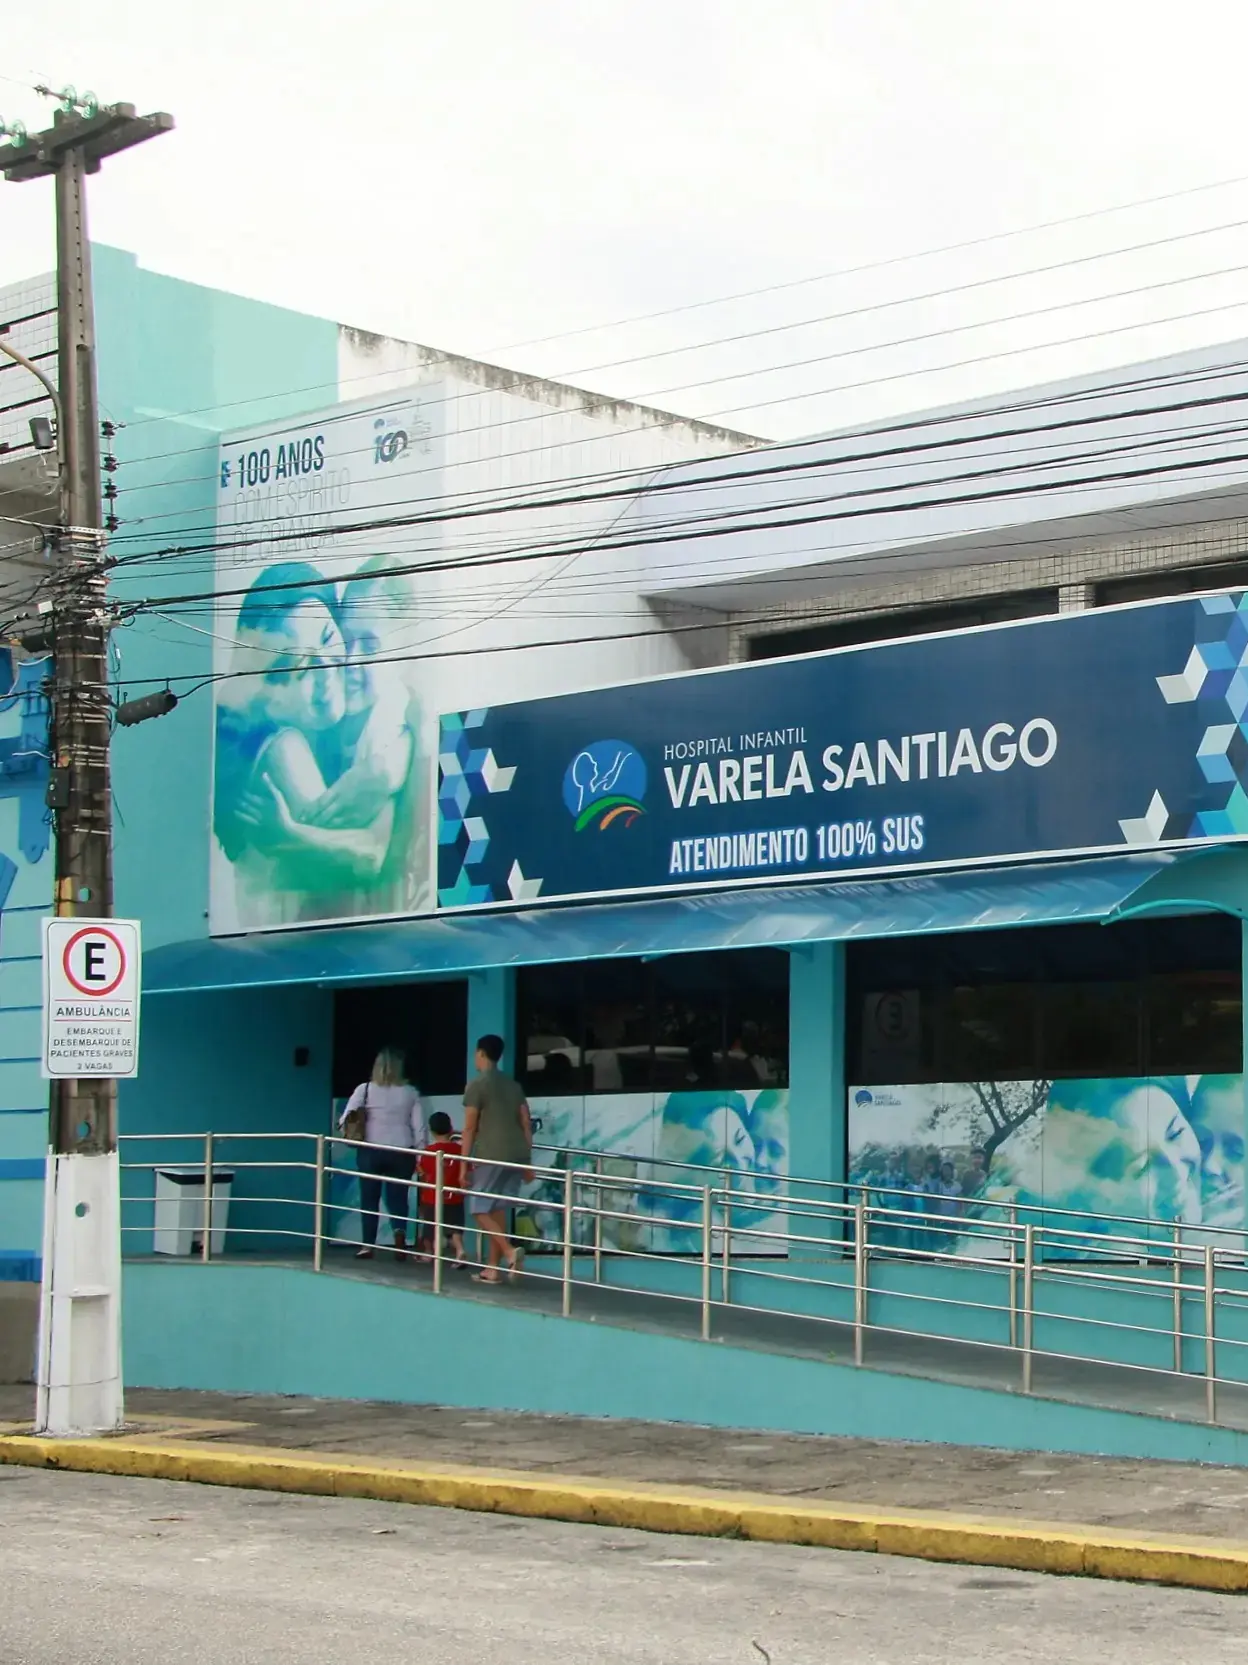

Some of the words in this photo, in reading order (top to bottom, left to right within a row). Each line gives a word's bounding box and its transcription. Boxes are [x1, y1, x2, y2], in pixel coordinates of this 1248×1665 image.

[238, 448, 270, 489] 100
[275, 435, 325, 480] ANOS
[664, 738, 734, 761] HOSPITAL
[739, 727, 808, 750] INFANTIL
[664, 751, 814, 809] VARELA
[821, 717, 1059, 792] SANTIAGO
[669, 828, 808, 874] ATENDIMENTO
[816, 820, 877, 859] 100%
[882, 815, 925, 853] SUS
[85, 942, 106, 981] E
[56, 1004, 131, 1017] AMBULÂNCIA
[53, 1038, 120, 1047] DESEMBARQUE
[122, 1038, 131, 1046] DE
[67, 1027, 116, 1036] EMBARQUE
[51, 1049, 101, 1058] PACIENTES
[103, 1049, 133, 1057] GRAVES
[84, 1062, 113, 1070] VAGAS
